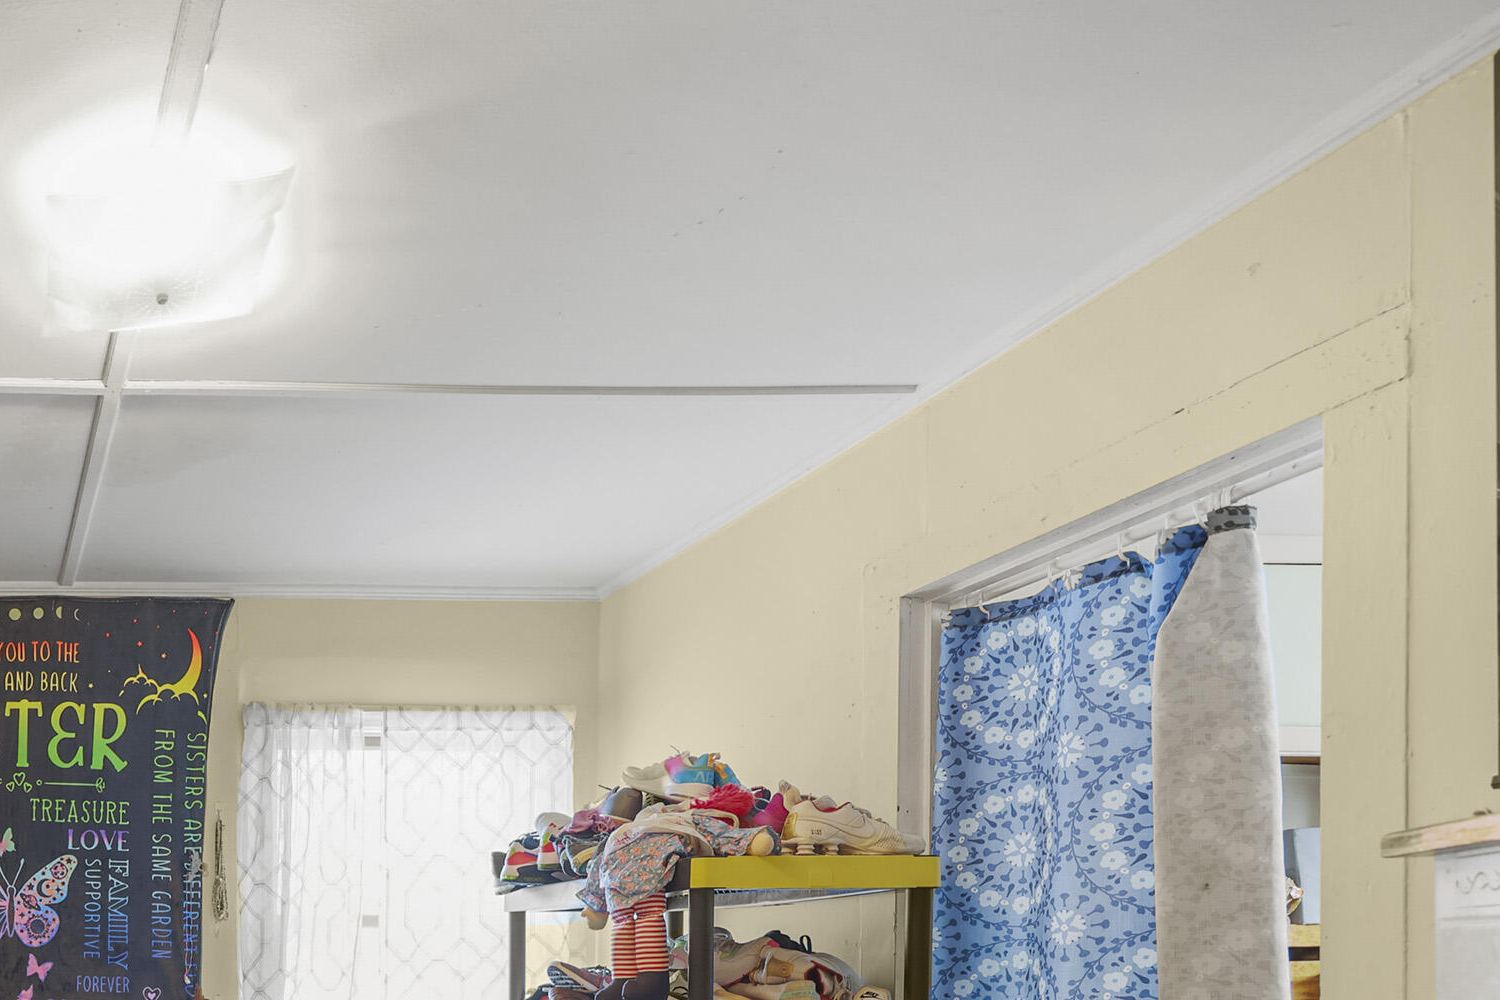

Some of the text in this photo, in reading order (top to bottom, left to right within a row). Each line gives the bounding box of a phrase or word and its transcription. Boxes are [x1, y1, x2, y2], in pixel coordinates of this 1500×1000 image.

[31, 641, 51, 662] TO
[56, 641, 80, 663] THE
[4, 671, 34, 691] AND
[40, 671, 78, 692] BACK
[184, 732, 207, 810] SISTERS
[30, 798, 130, 825] TREASURE
[67, 828, 130, 852] LOVE
[151, 729, 176, 959] FROM THE SAME GARDEN
[182, 819, 203, 854] ARE
[84, 858, 102, 959] SUPPORTIVE
[108, 858, 130, 970] FAMILY
[76, 975, 130, 993] FOREVER
